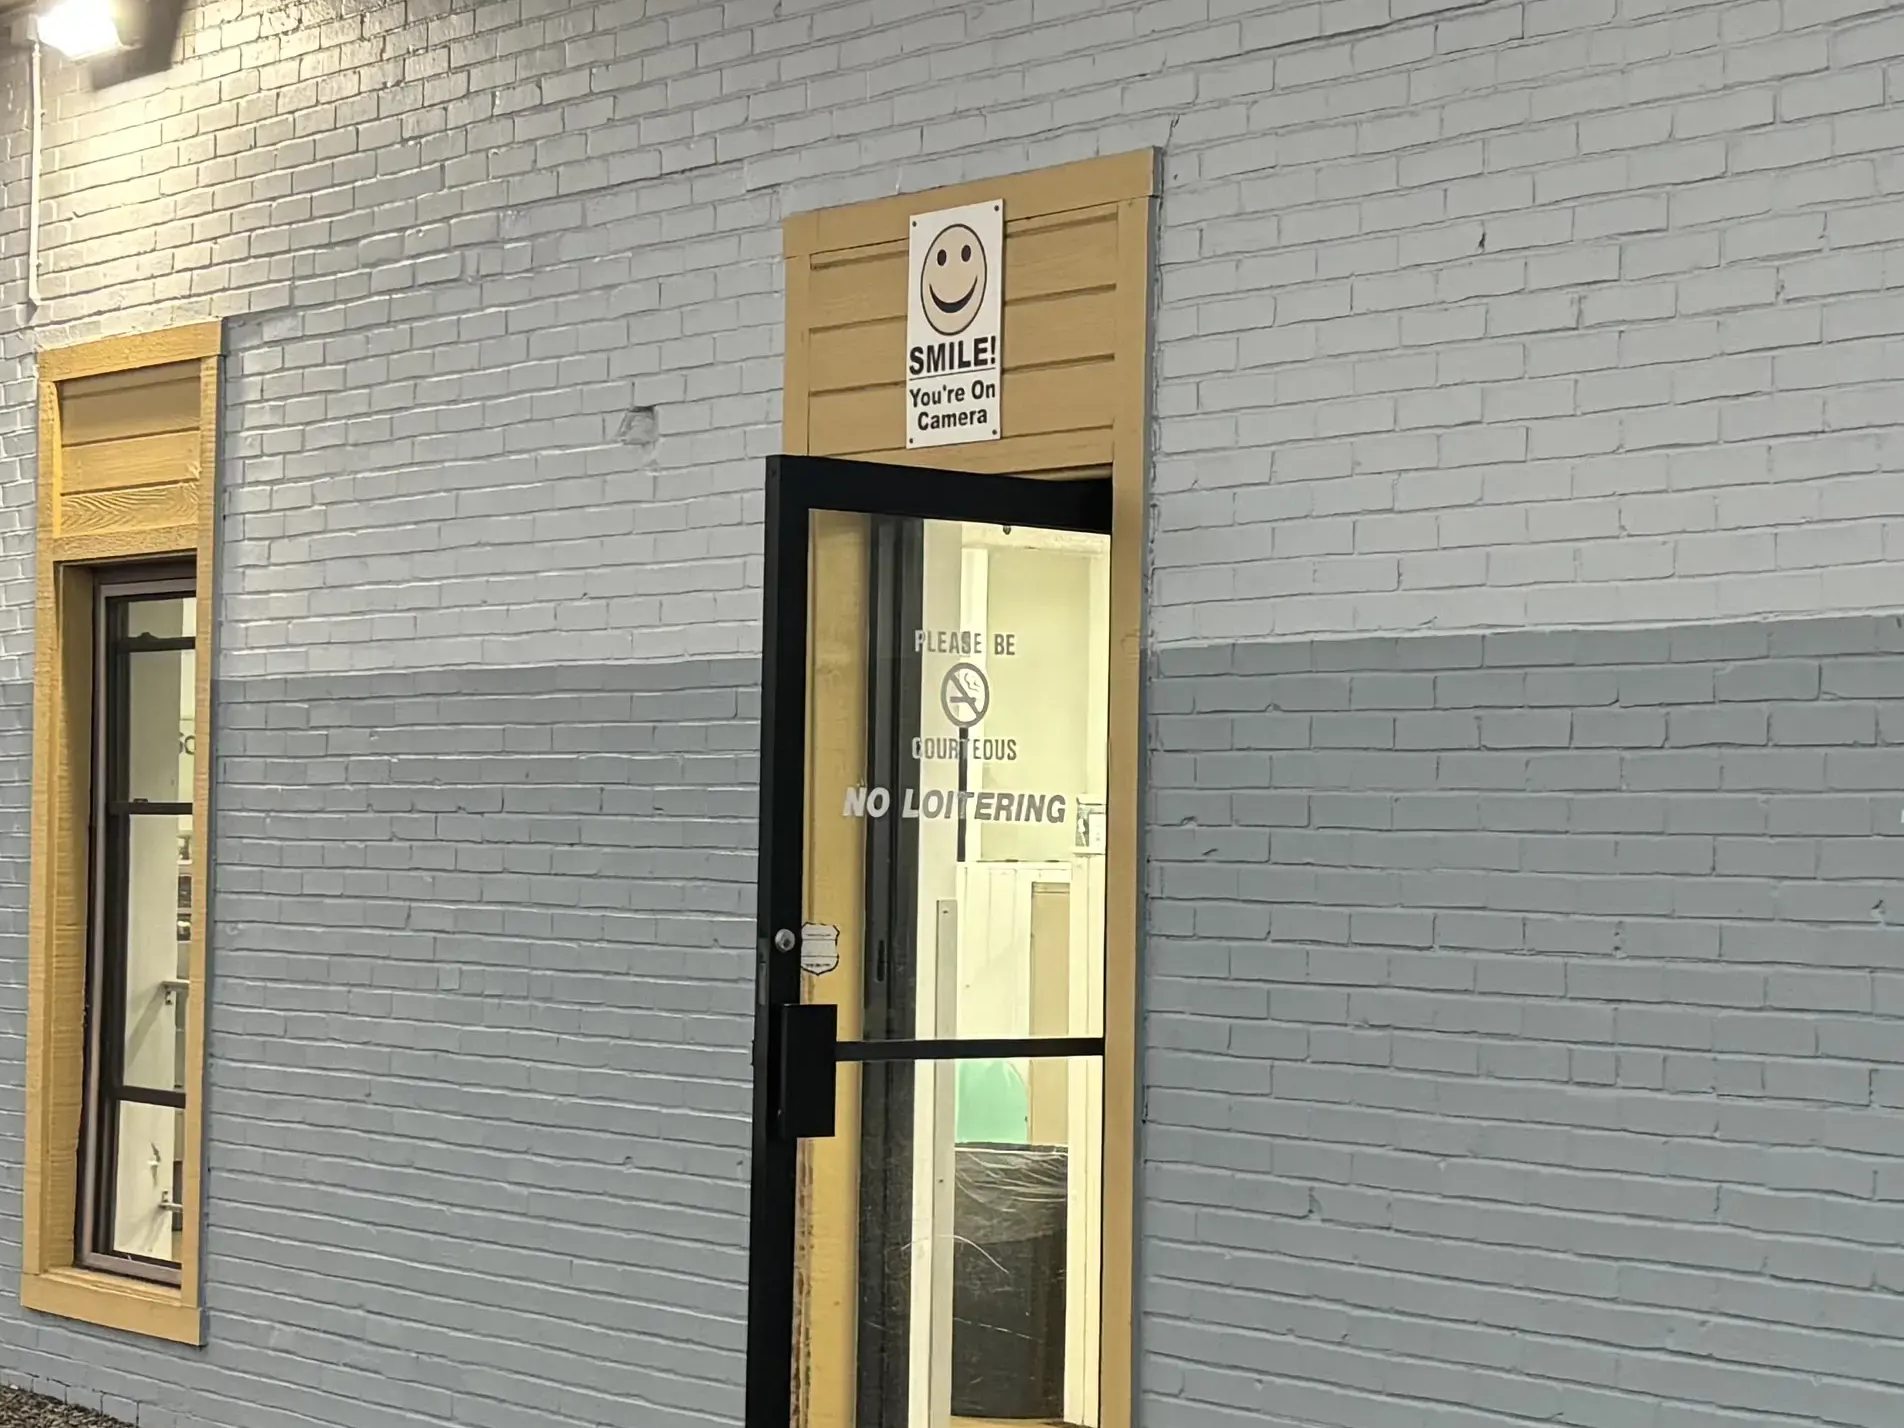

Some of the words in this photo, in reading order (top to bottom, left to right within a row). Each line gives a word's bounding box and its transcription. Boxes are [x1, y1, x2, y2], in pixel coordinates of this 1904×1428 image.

[909, 335, 996, 375] SMILE!
[909, 384, 965, 408] You're
[971, 379, 996, 400] On
[917, 408, 988, 431] Camera
[914, 629, 983, 655] PLEASE
[994, 633, 1016, 656] BE
[911, 736, 1018, 761] COURTEOUS
[843, 786, 891, 819] NO
[901, 788, 1067, 824] LOITERING
